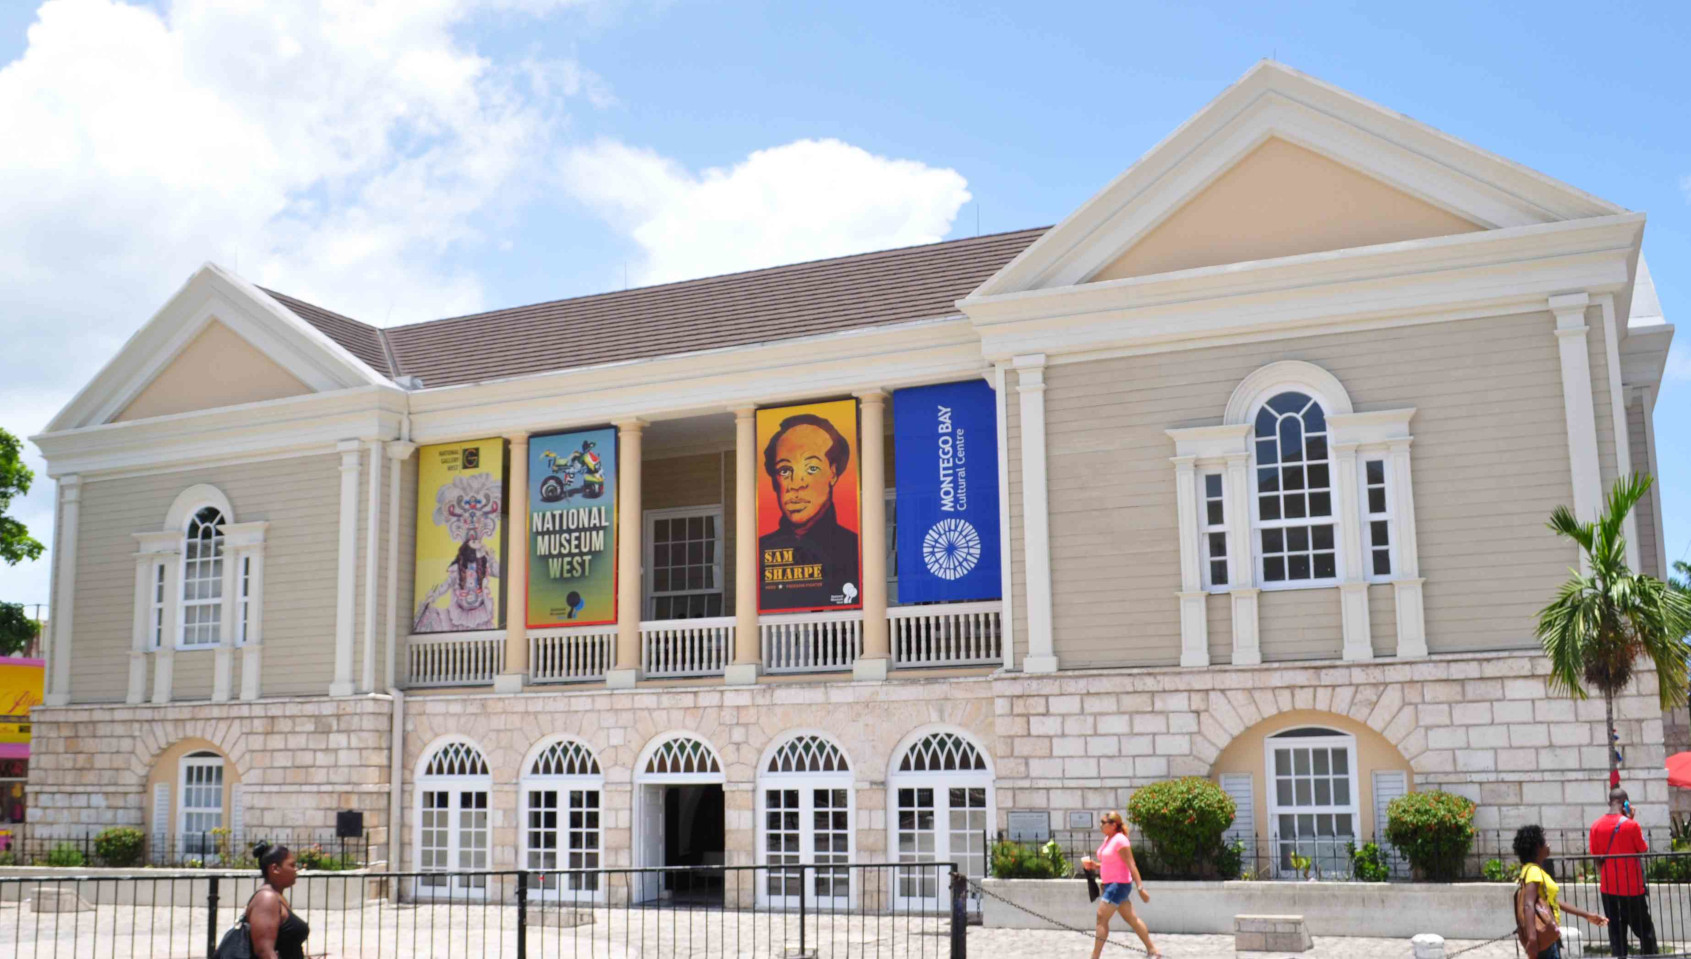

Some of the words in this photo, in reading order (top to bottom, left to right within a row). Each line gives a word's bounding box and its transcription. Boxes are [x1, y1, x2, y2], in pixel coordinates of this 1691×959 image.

[937, 405, 952, 434] BAY
[955, 428, 966, 465] Centre
[939, 435, 955, 512] MONTEGO
[956, 466, 967, 511] Cultural
[532, 506, 610, 533] NATIONAL
[536, 530, 605, 556] MUSEUM
[764, 548, 794, 565] SAM
[548, 555, 592, 579] WEST
[764, 564, 823, 583] SHARPE
